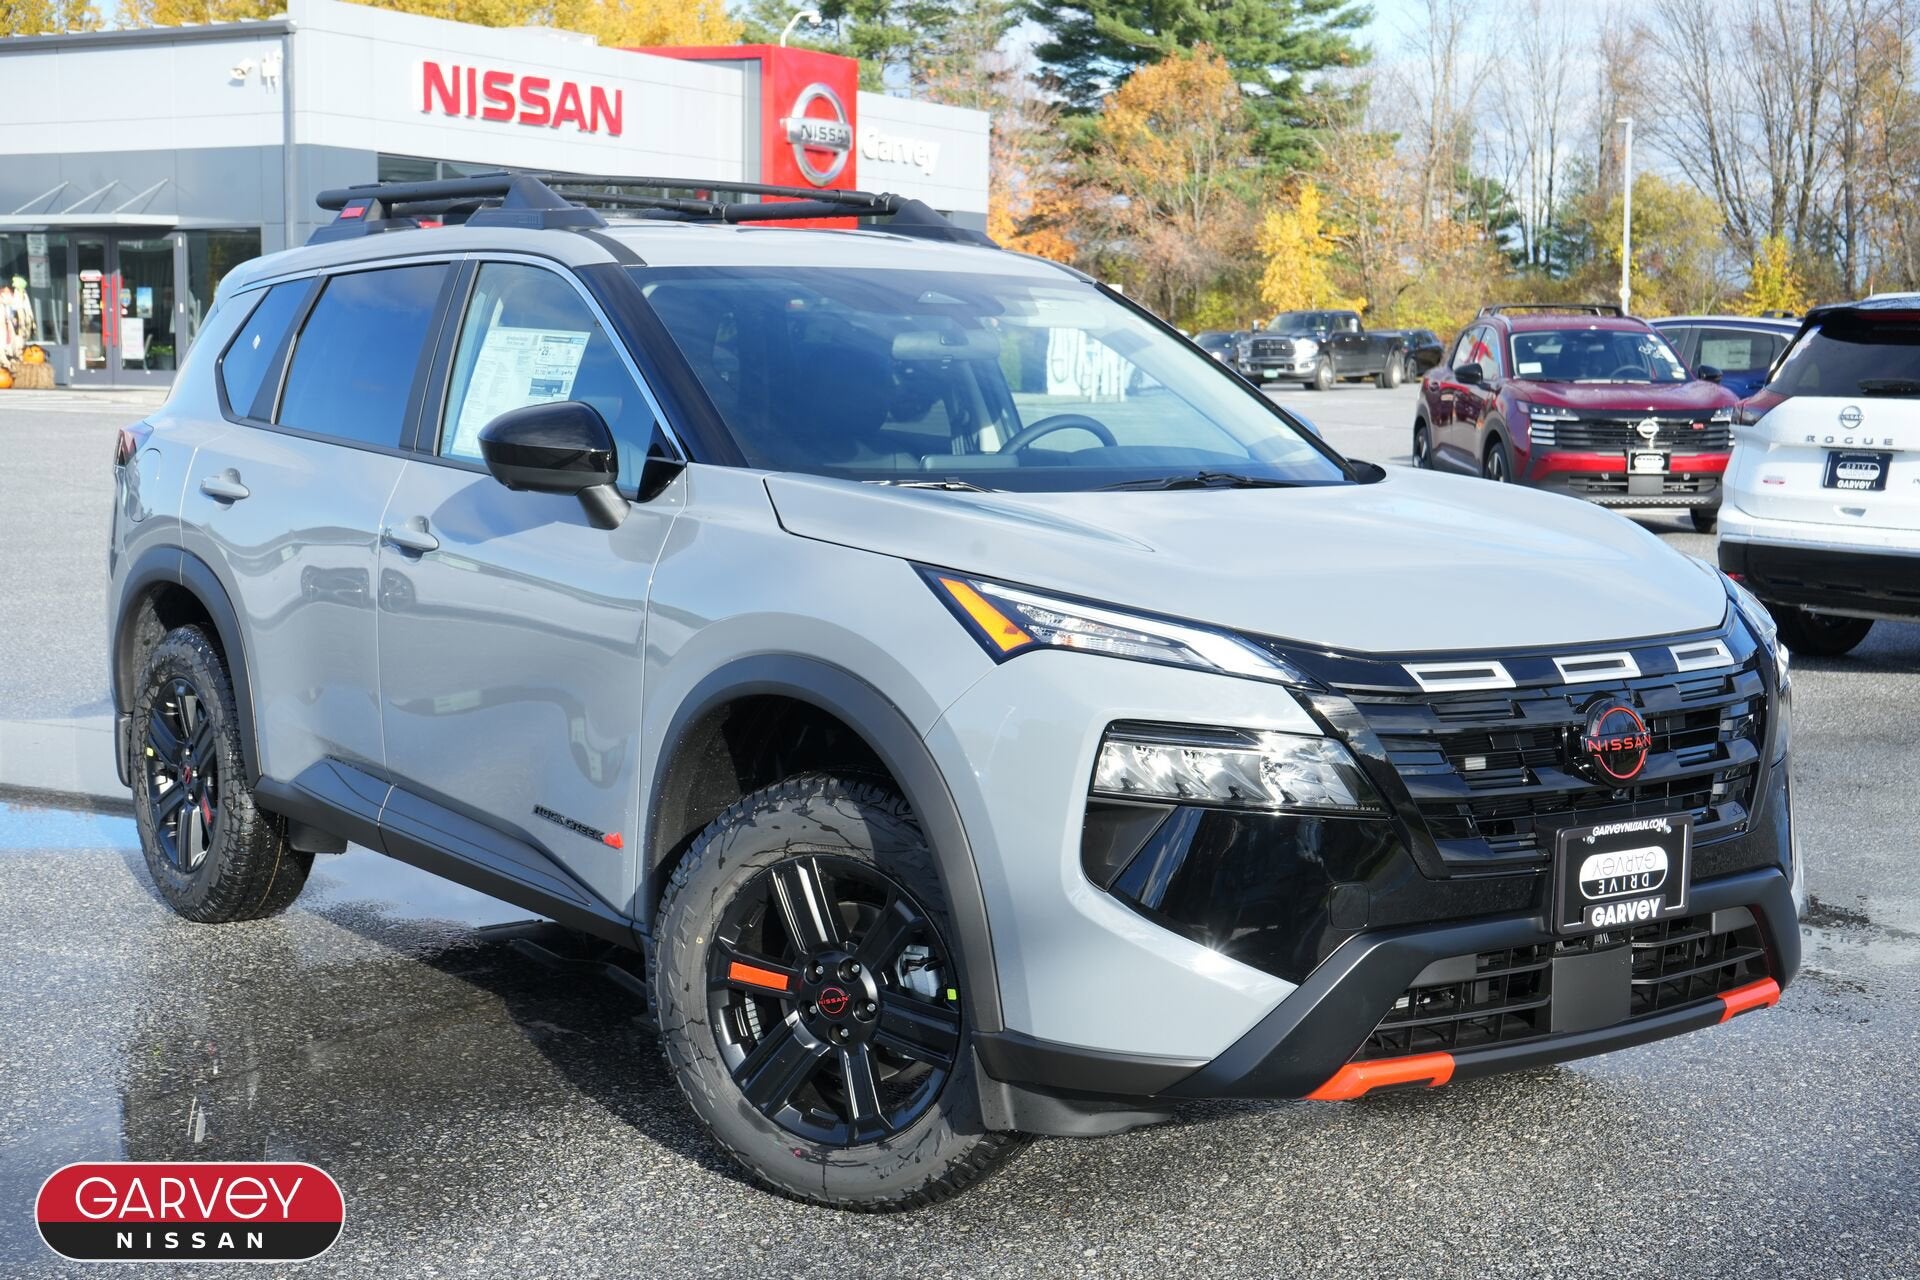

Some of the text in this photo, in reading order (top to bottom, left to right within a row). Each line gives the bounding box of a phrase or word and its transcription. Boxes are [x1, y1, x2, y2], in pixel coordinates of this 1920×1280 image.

[423, 61, 622, 136] NISSAN
[862, 127, 941, 176] Garvey
[1806, 435, 1894, 446] ROGUE
[1837, 480, 1871, 489] GARVEY
[1588, 735, 1652, 752] NISSAN
[1592, 851, 1658, 878] GARVEY
[1598, 872, 1650, 894] DRIVE
[1591, 898, 1661, 927] GARVEY
[819, 996, 848, 1005] NISSAN
